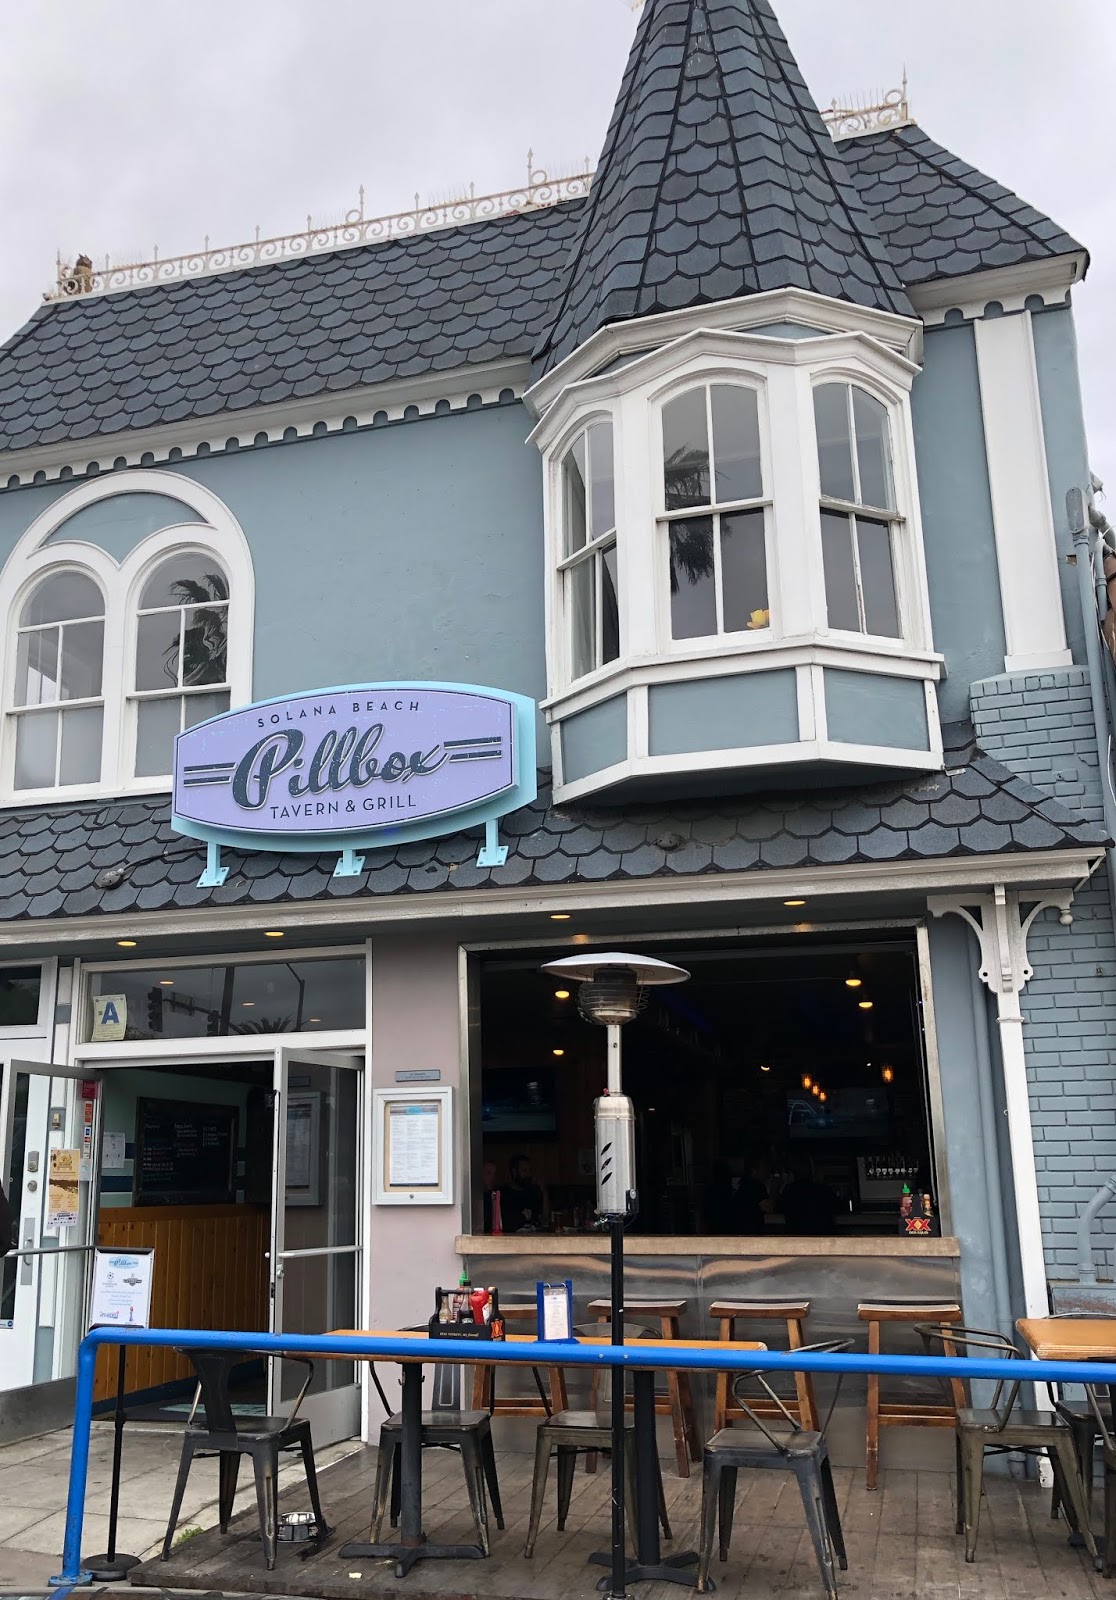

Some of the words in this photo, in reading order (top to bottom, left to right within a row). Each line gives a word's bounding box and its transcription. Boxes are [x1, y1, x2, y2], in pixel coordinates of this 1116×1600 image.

[257, 705, 336, 727] SOLANA
[352, 701, 419, 712] BEACH
[232, 723, 448, 810] Pillbox
[270, 800, 338, 819] TAVERN
[345, 799, 356, 813] &
[362, 795, 417, 811] GRILL
[101, 1002, 120, 1024] A
